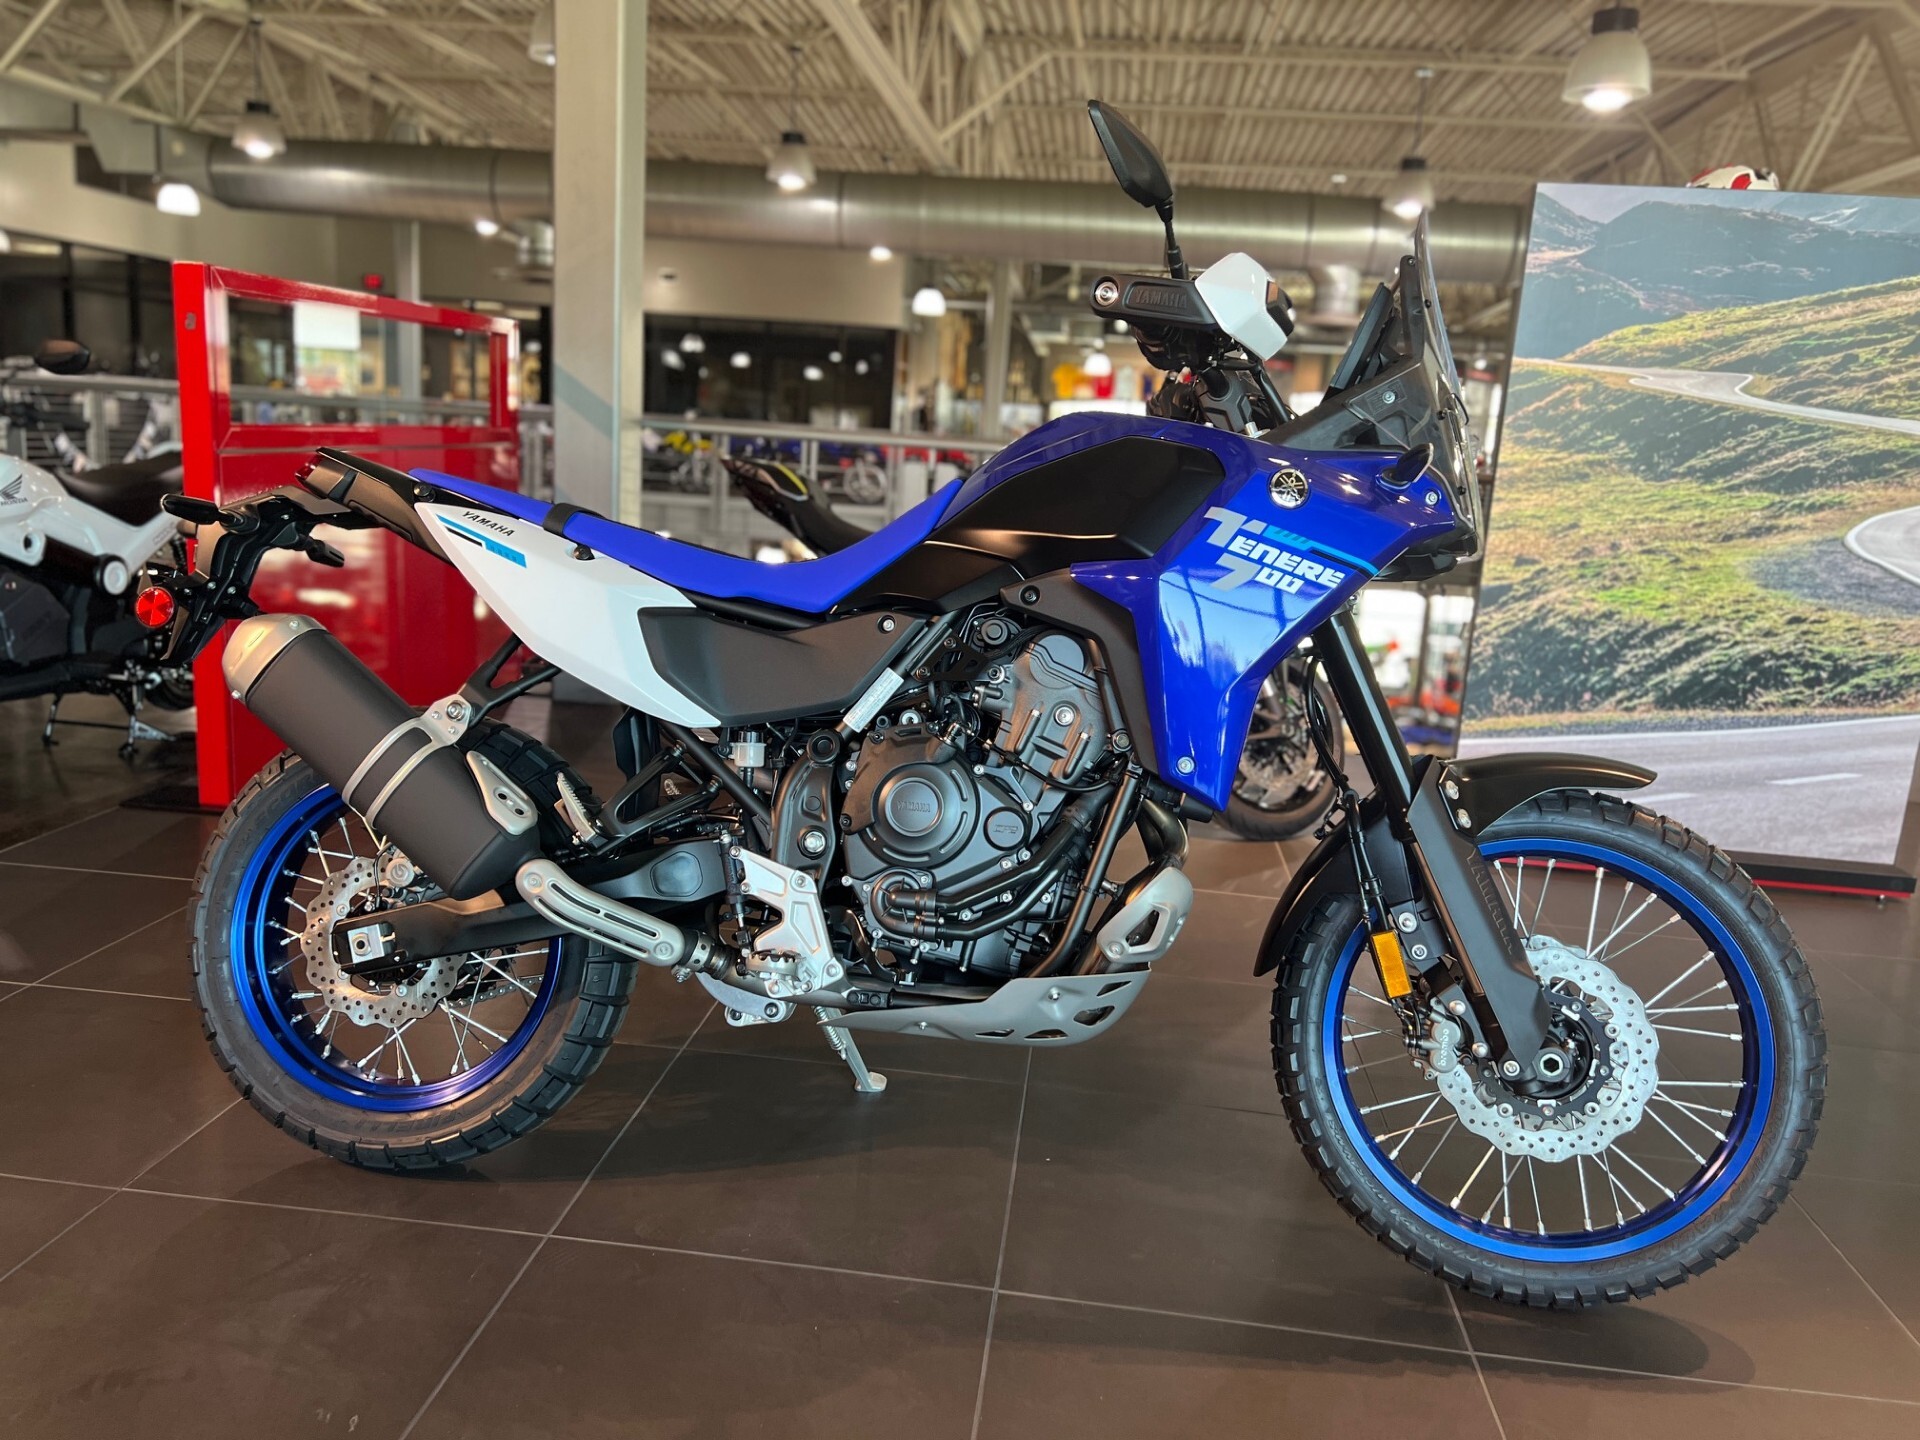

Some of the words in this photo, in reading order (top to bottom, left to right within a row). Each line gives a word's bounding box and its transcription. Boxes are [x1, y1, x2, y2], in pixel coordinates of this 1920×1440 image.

[1135, 289, 1187, 308] YAMAHA
[0, 497, 28, 506] HONDA
[462, 510, 516, 537] YAMAHA
[1209, 552, 1305, 595] 700
[896, 800, 931, 812] YAMAHA
[1466, 847, 1514, 956] YAMAHA
[1437, 1028, 1450, 1066] brembo
